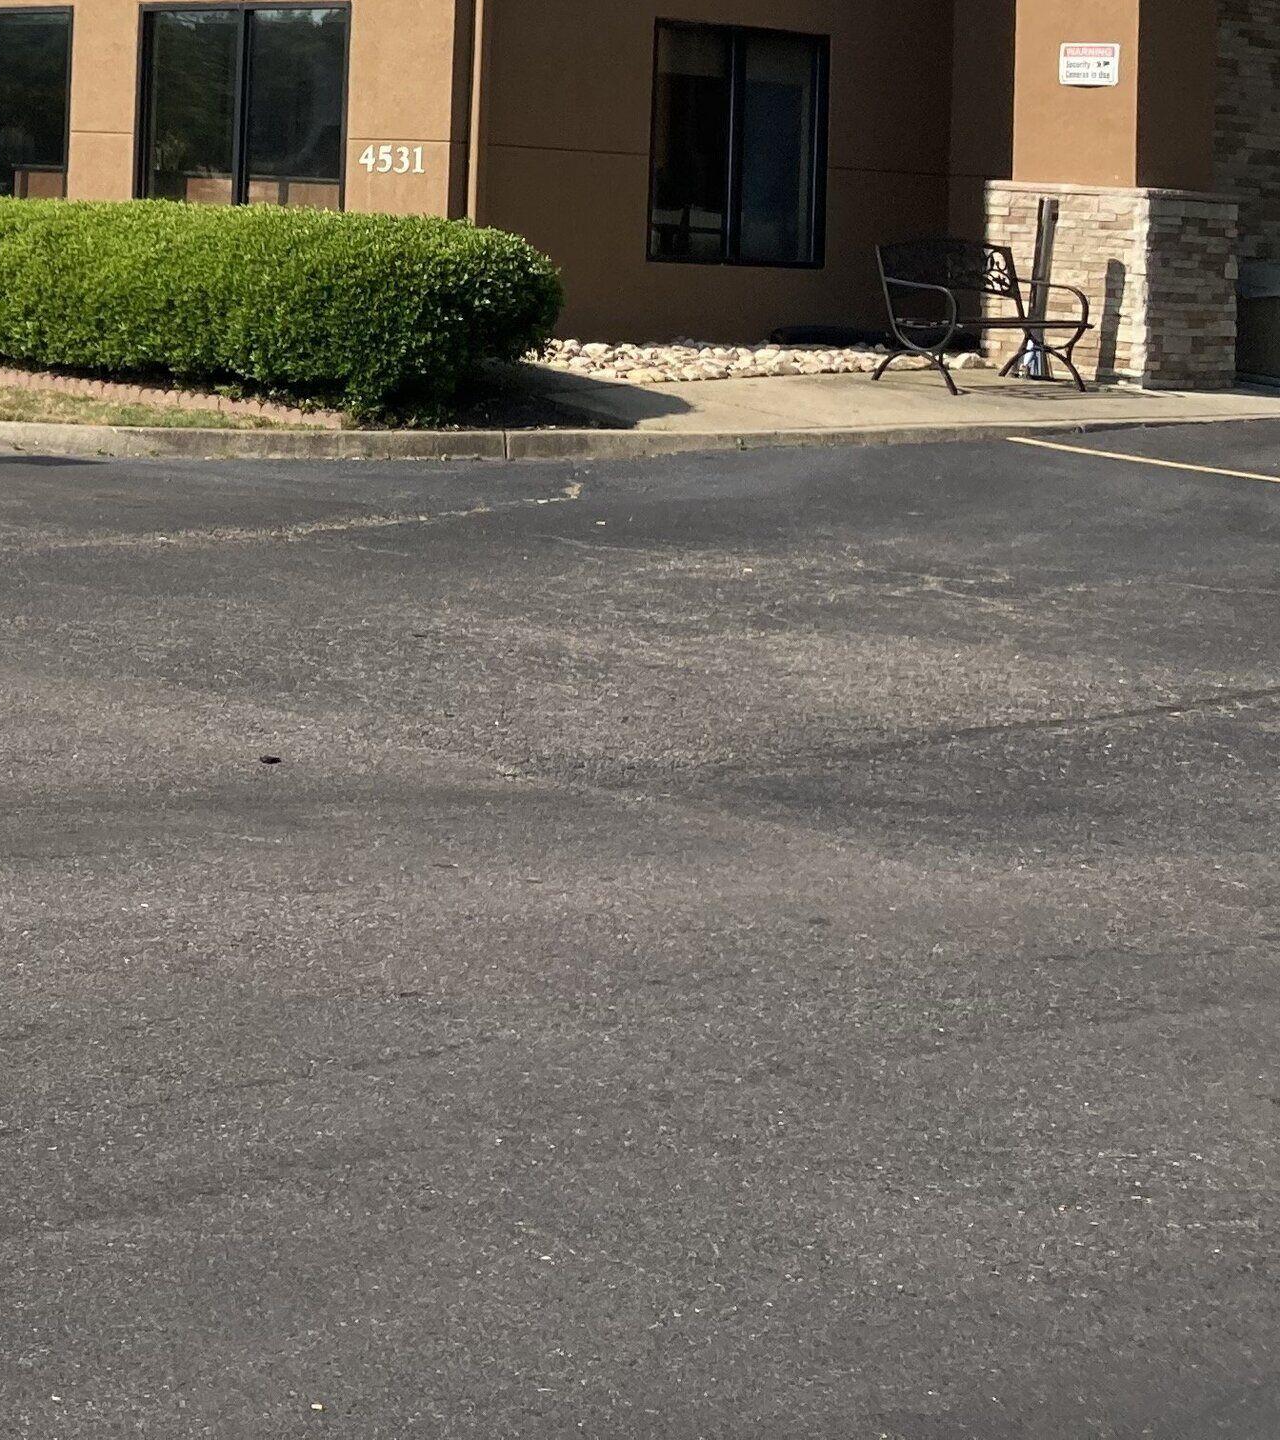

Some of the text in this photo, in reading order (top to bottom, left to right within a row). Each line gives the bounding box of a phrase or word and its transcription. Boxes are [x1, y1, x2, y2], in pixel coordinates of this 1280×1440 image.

[1066, 47, 1113, 57] WARNING
[1066, 61, 1091, 69] Security
[358, 144, 425, 174] 4531
